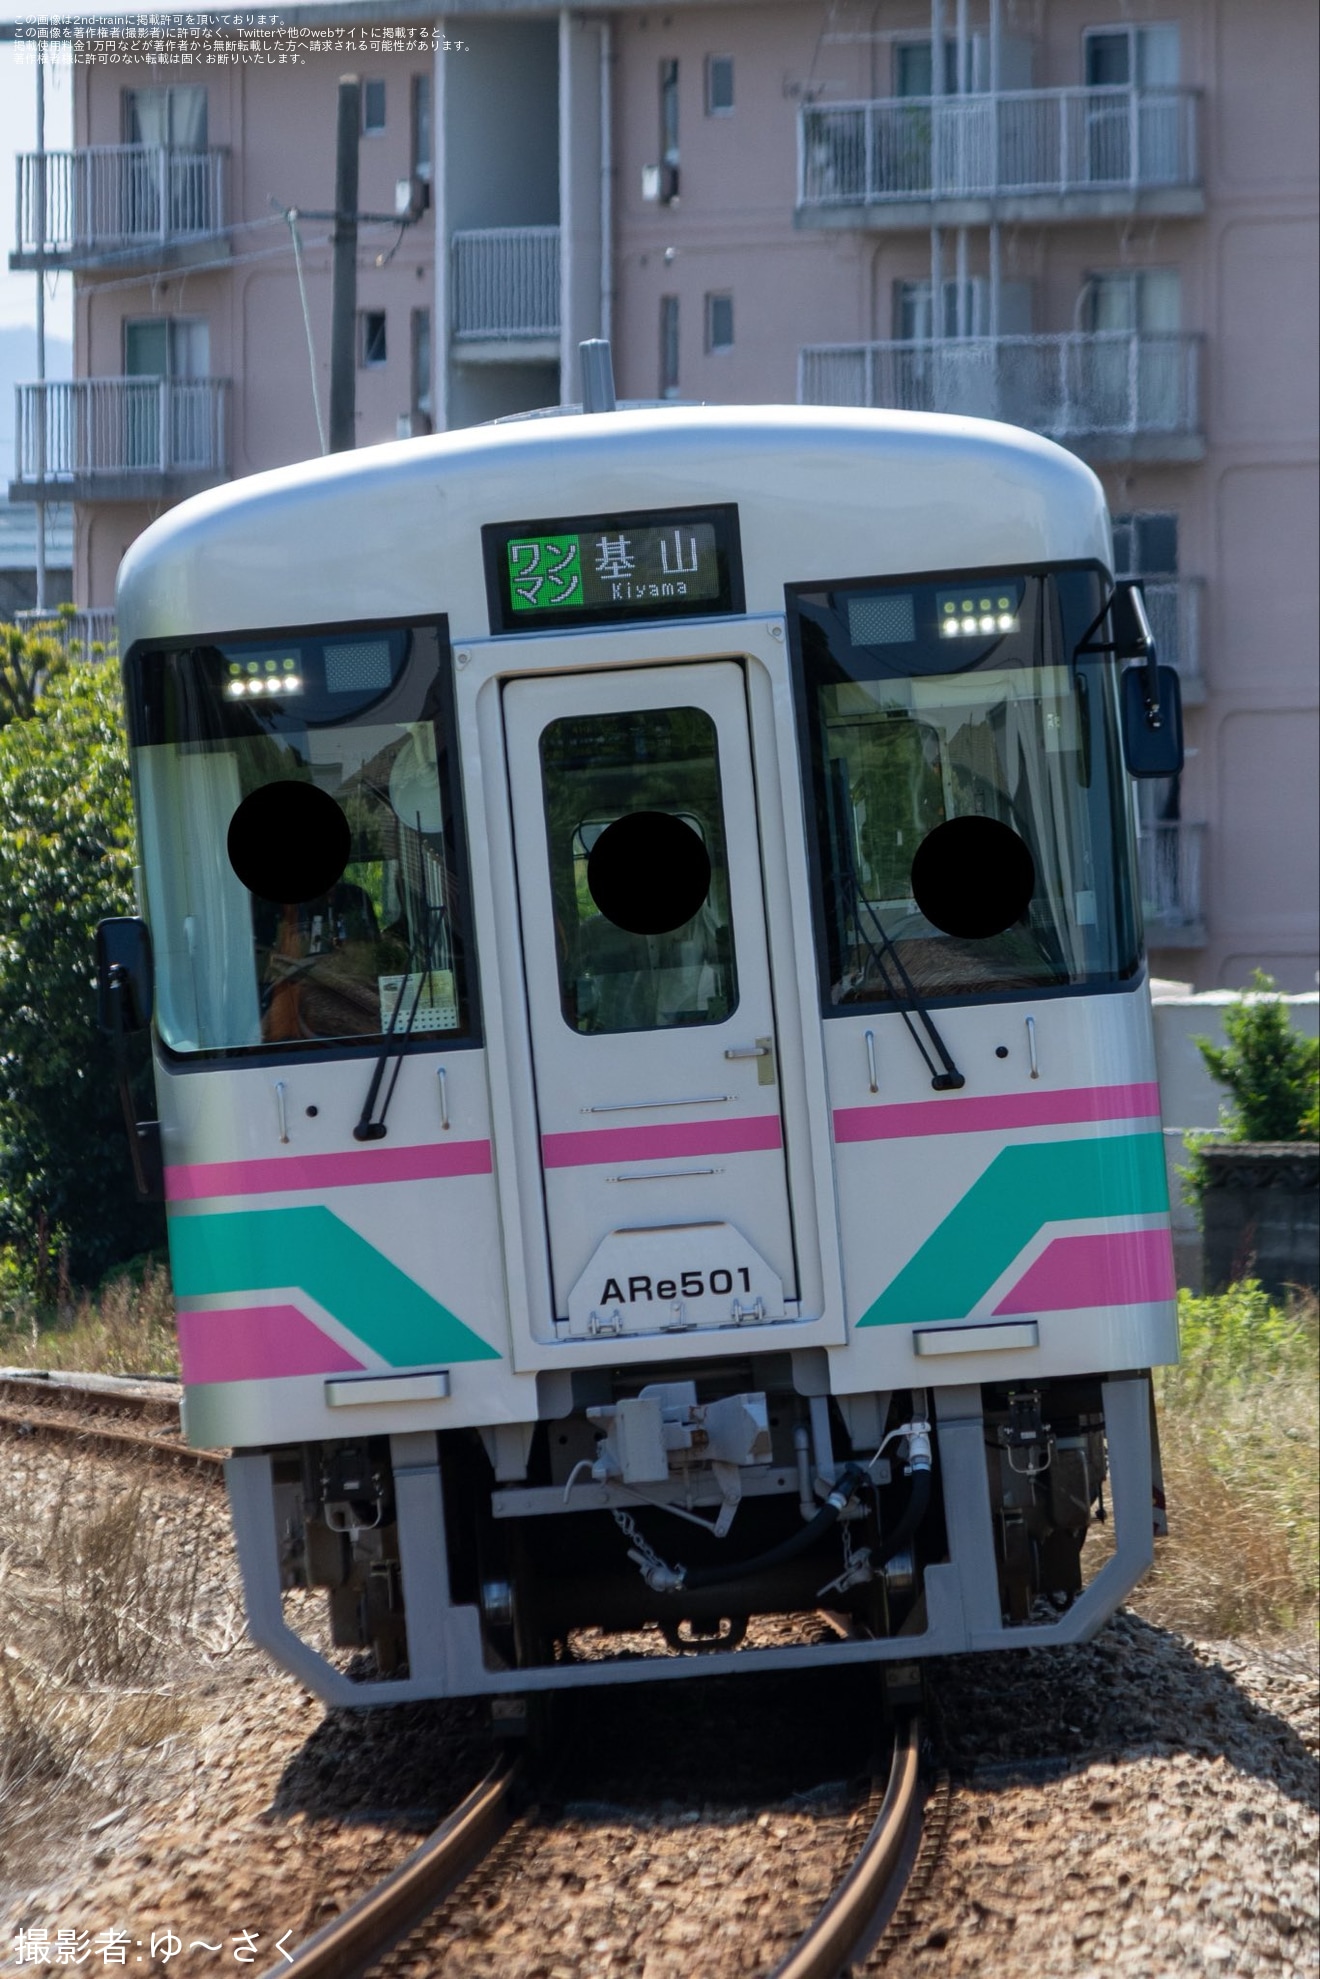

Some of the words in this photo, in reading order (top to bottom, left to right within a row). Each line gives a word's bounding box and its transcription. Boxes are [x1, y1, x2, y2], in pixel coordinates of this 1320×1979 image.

[511, 544, 576, 576] ワン
[595, 530, 698, 580] 基山
[514, 574, 579, 604] マン
[612, 581, 687, 600] Kiyama
[600, 1267, 750, 1305] ARe501
